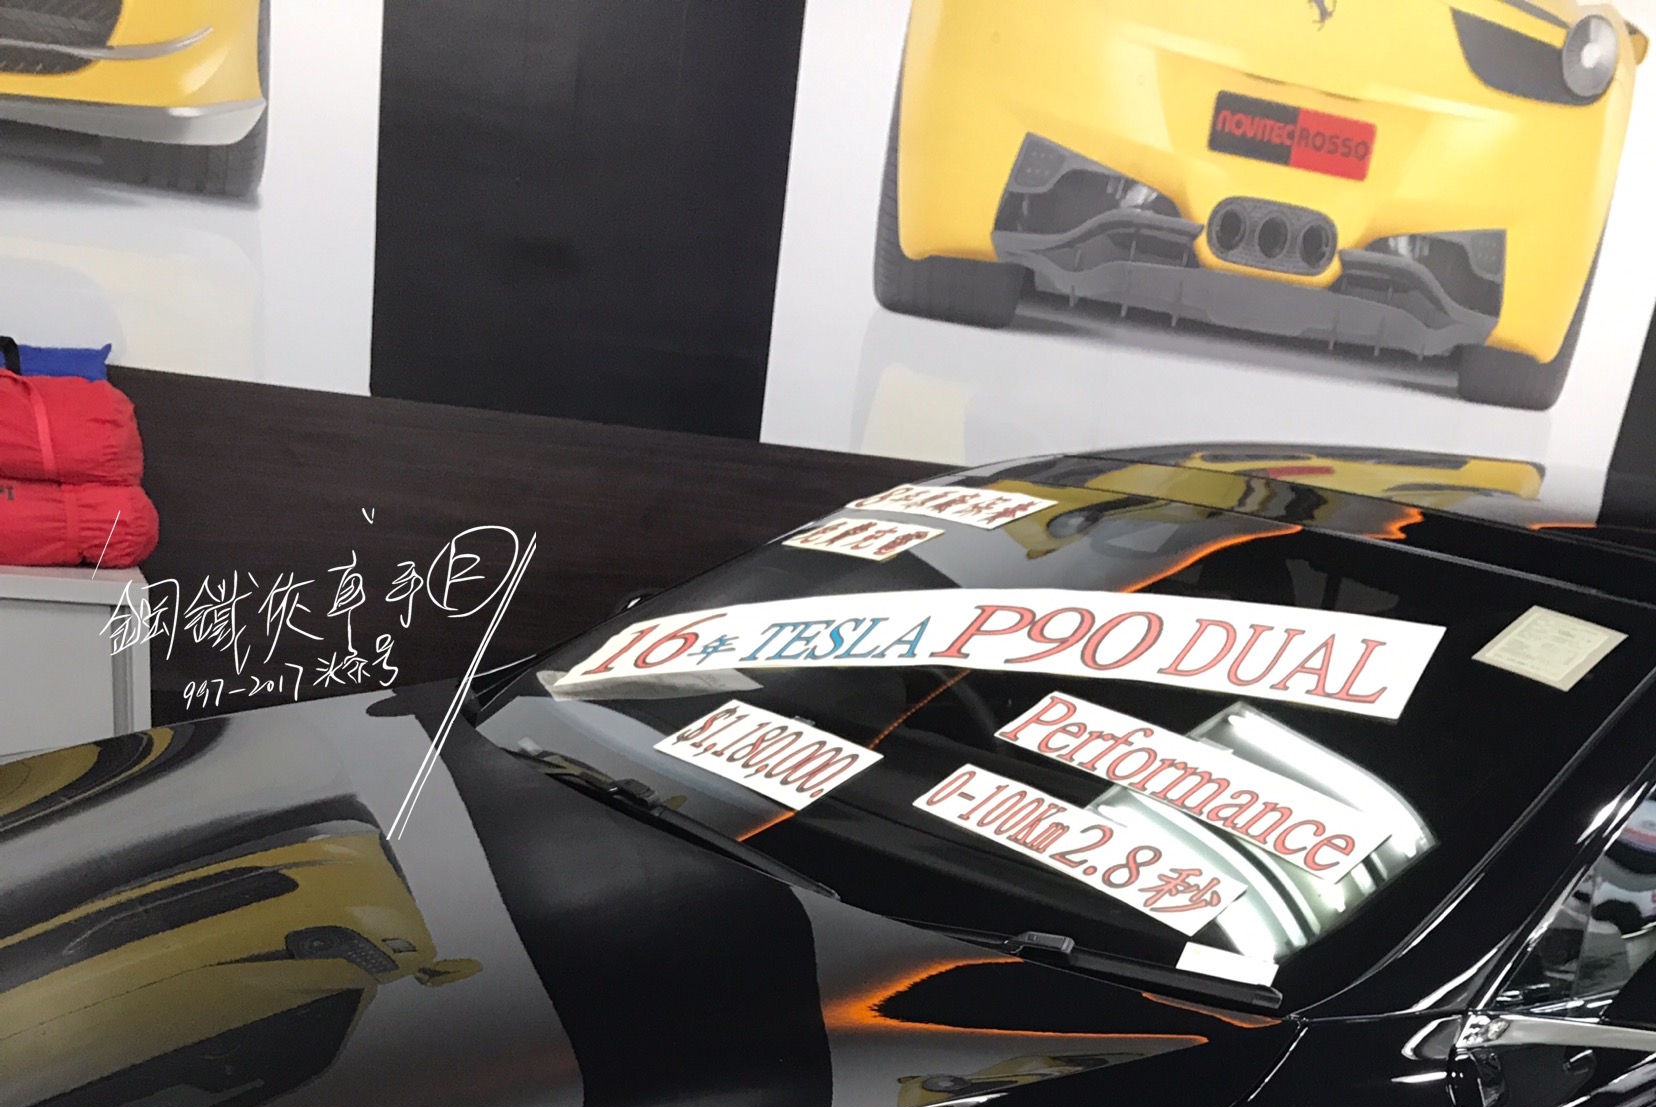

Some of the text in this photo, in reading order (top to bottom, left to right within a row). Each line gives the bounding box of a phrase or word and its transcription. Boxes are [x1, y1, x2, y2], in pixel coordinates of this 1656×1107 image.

[1216, 110, 1370, 161] NOVITEC ROSSO
[739, 615, 931, 662] TESLA
[929, 604, 1164, 671] P90
[1157, 618, 1388, 704] DUAL
[1000, 696, 1356, 871] Performance
